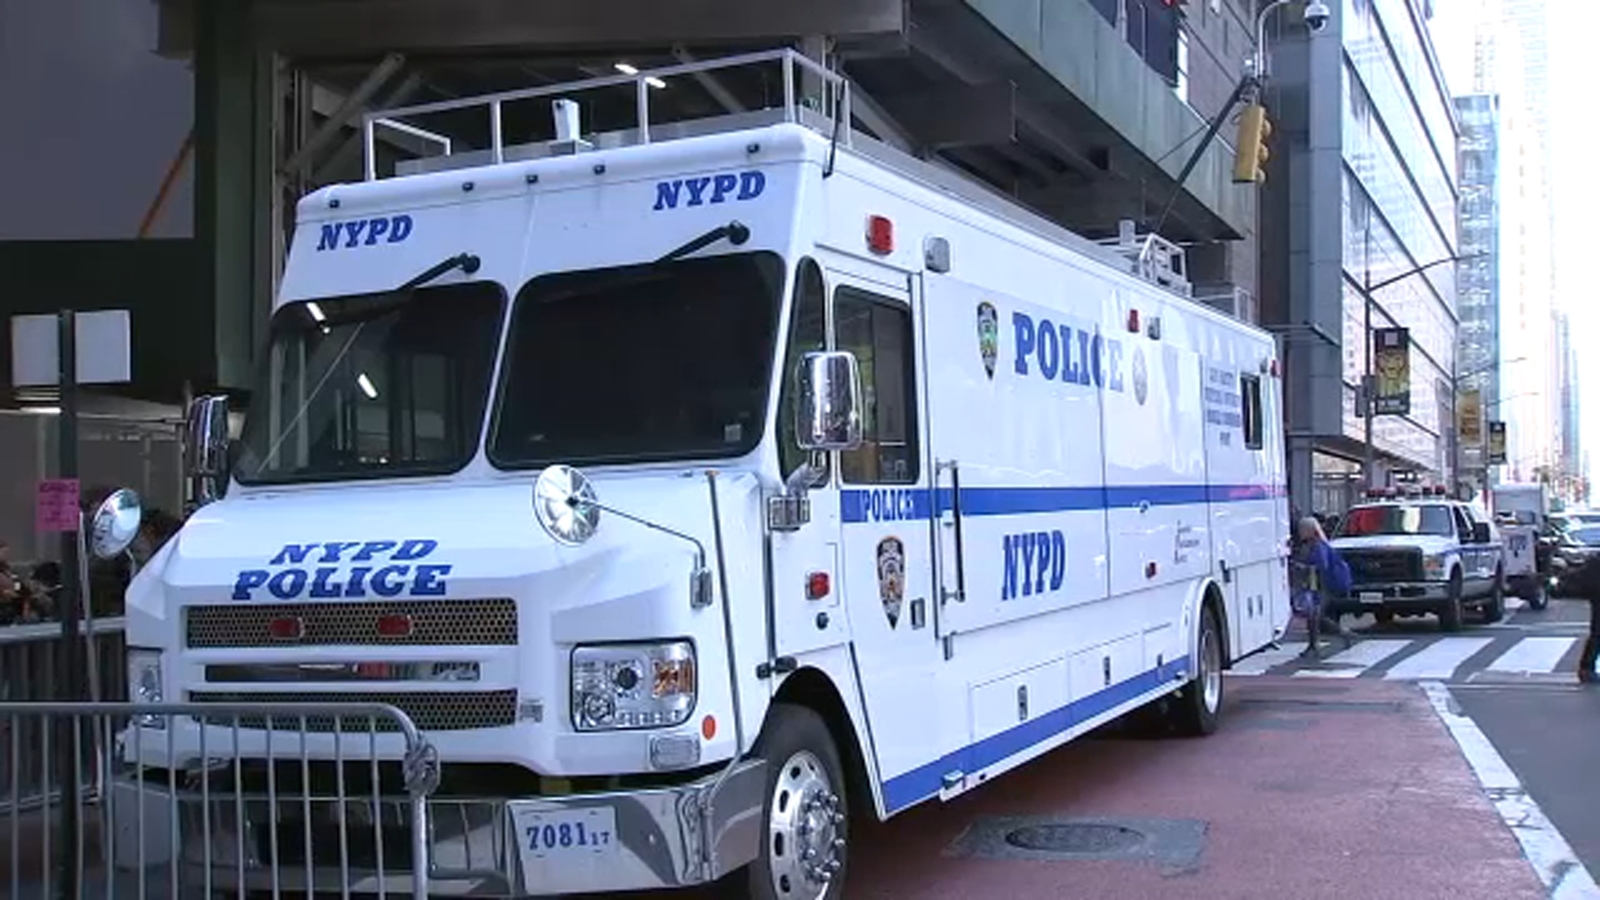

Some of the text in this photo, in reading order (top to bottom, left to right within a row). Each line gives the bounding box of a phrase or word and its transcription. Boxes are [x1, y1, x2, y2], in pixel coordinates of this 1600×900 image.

[653, 170, 766, 211] NYPD
[316, 214, 413, 251] NYPD
[1012, 311, 1124, 392] POLICE
[859, 488, 914, 522] POLICE
[269, 539, 438, 566] NYPD
[1002, 530, 1066, 601] NYPD
[231, 564, 452, 601] POLICE
[526, 822, 587, 850] 7081
